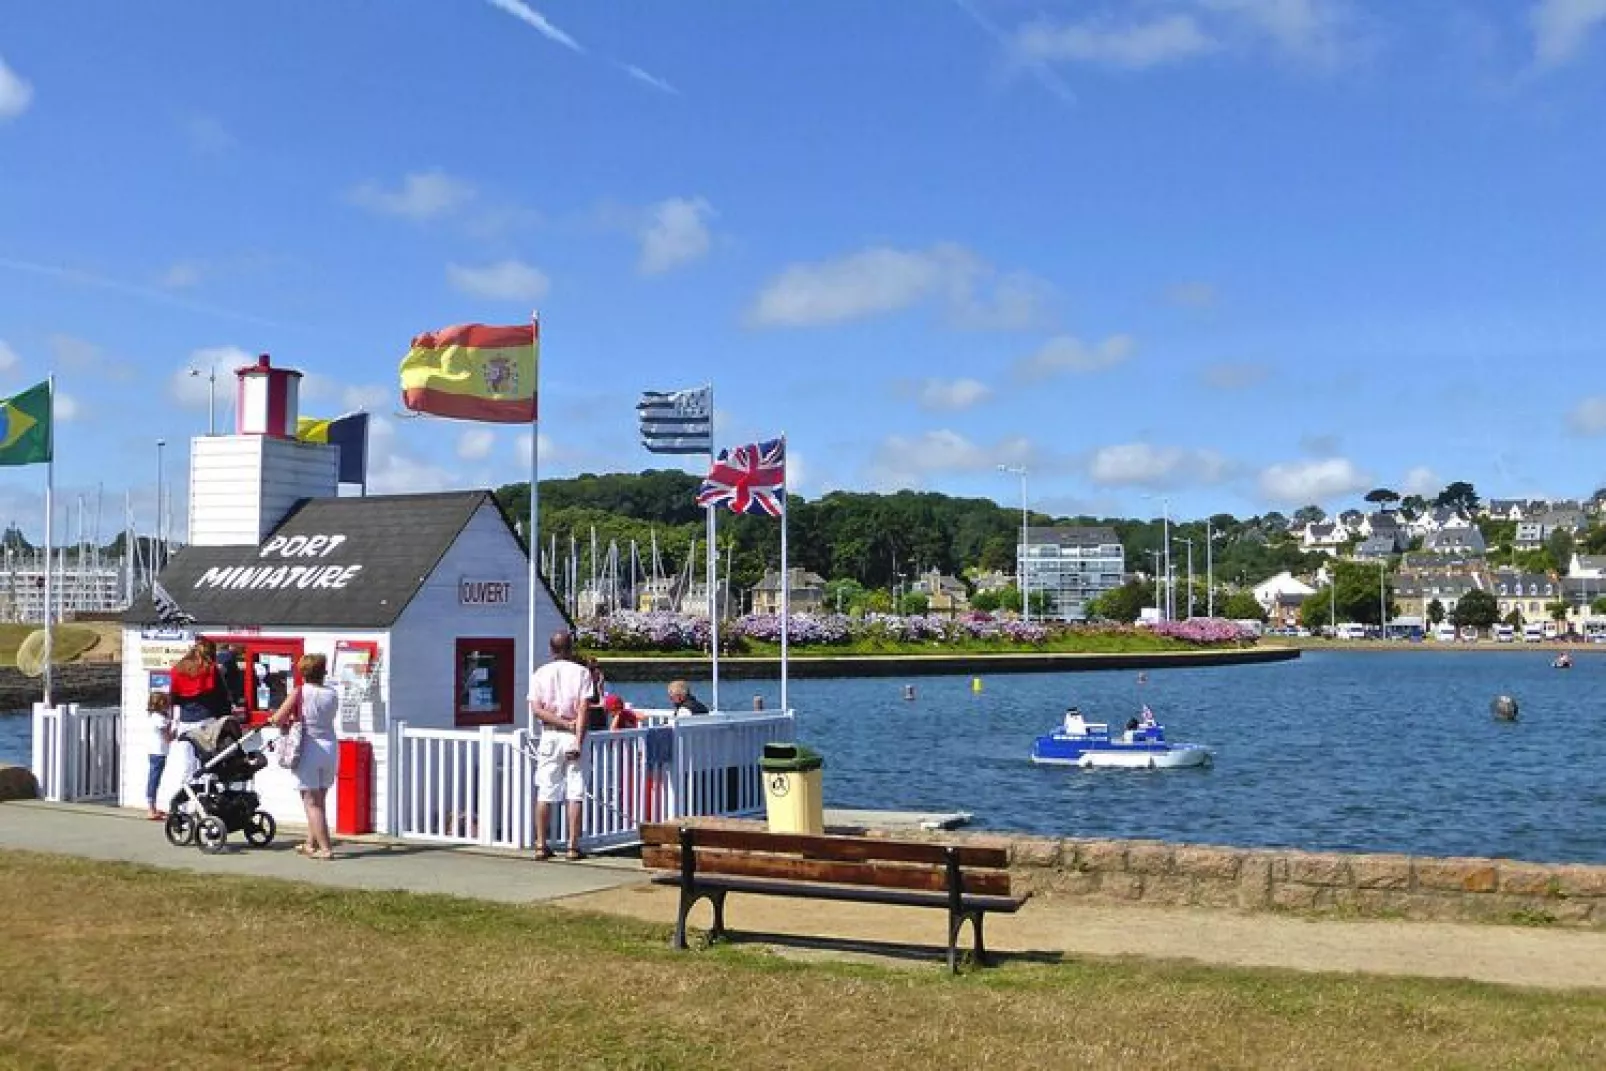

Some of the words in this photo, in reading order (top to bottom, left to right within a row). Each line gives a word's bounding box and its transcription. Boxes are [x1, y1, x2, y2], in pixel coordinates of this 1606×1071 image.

[260, 534, 346, 557] PORT
[194, 565, 363, 588] MINIATURE
[462, 582, 510, 603] OUVERT
